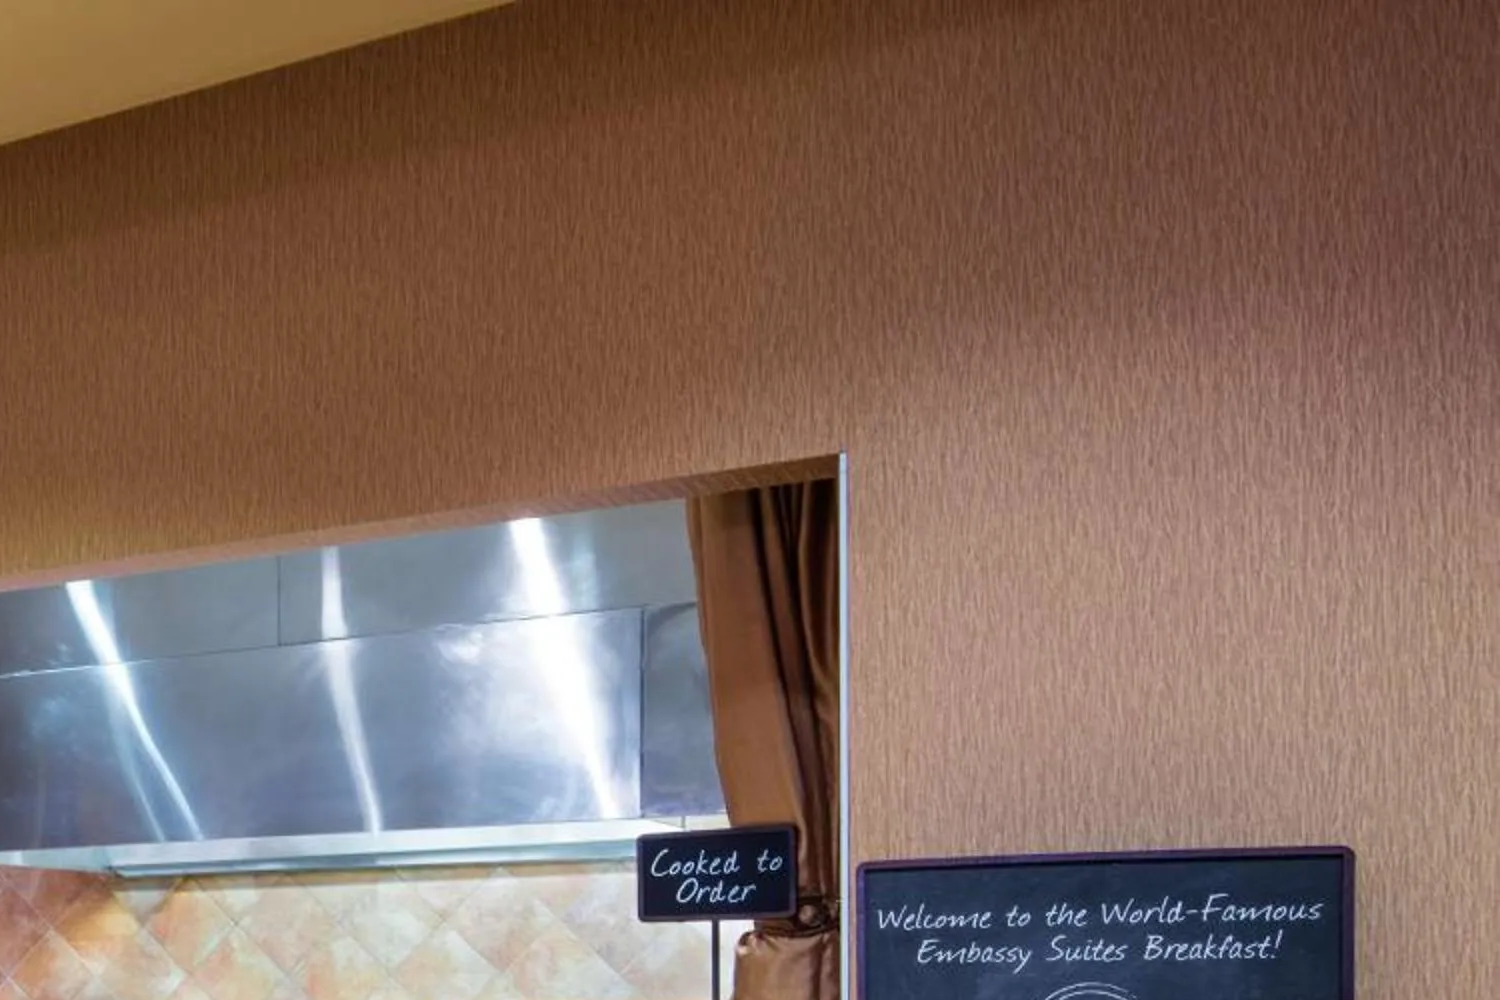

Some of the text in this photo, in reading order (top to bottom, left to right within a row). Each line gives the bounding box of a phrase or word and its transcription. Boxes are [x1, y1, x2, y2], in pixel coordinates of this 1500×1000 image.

[651, 848, 783, 877] Cooked to
[675, 877, 756, 903] Order
[877, 893, 1324, 931] Welcome to the World-Famous
[916, 929, 1284, 975] Embassy Suites Breakfast!
